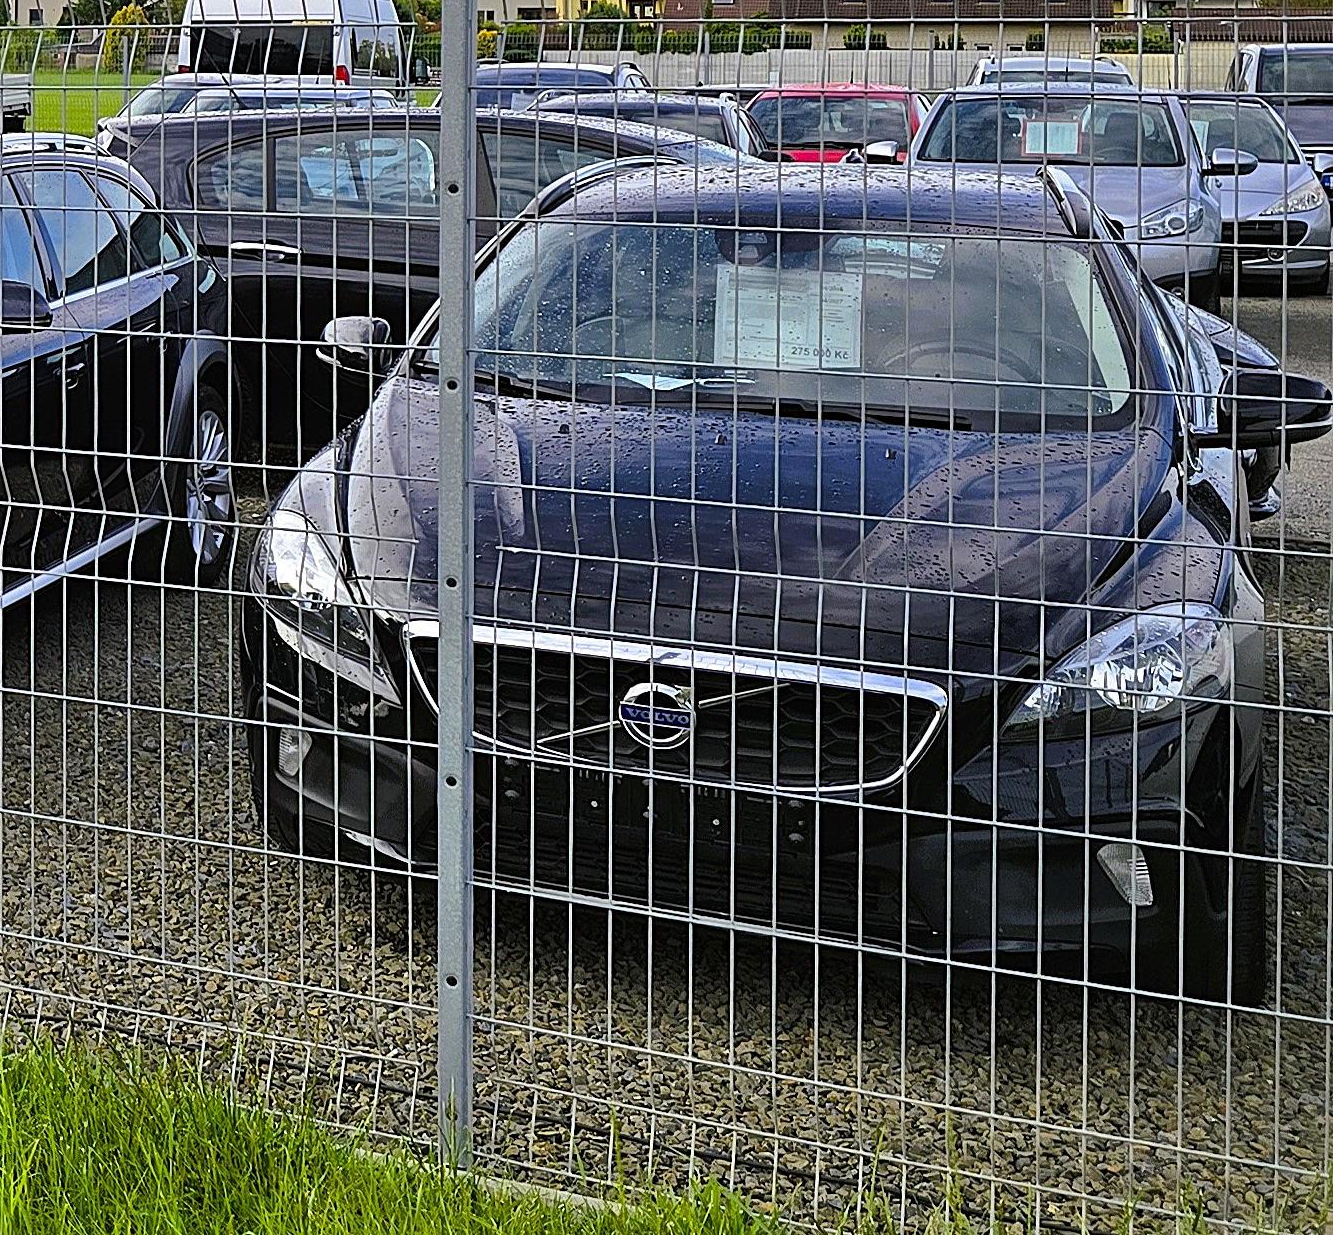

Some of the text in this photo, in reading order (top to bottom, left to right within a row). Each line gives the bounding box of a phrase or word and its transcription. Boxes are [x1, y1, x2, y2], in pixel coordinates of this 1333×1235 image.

[791, 346, 810, 356] 275
[834, 349, 850, 360] Kč
[625, 707, 689, 724] VOLVO
